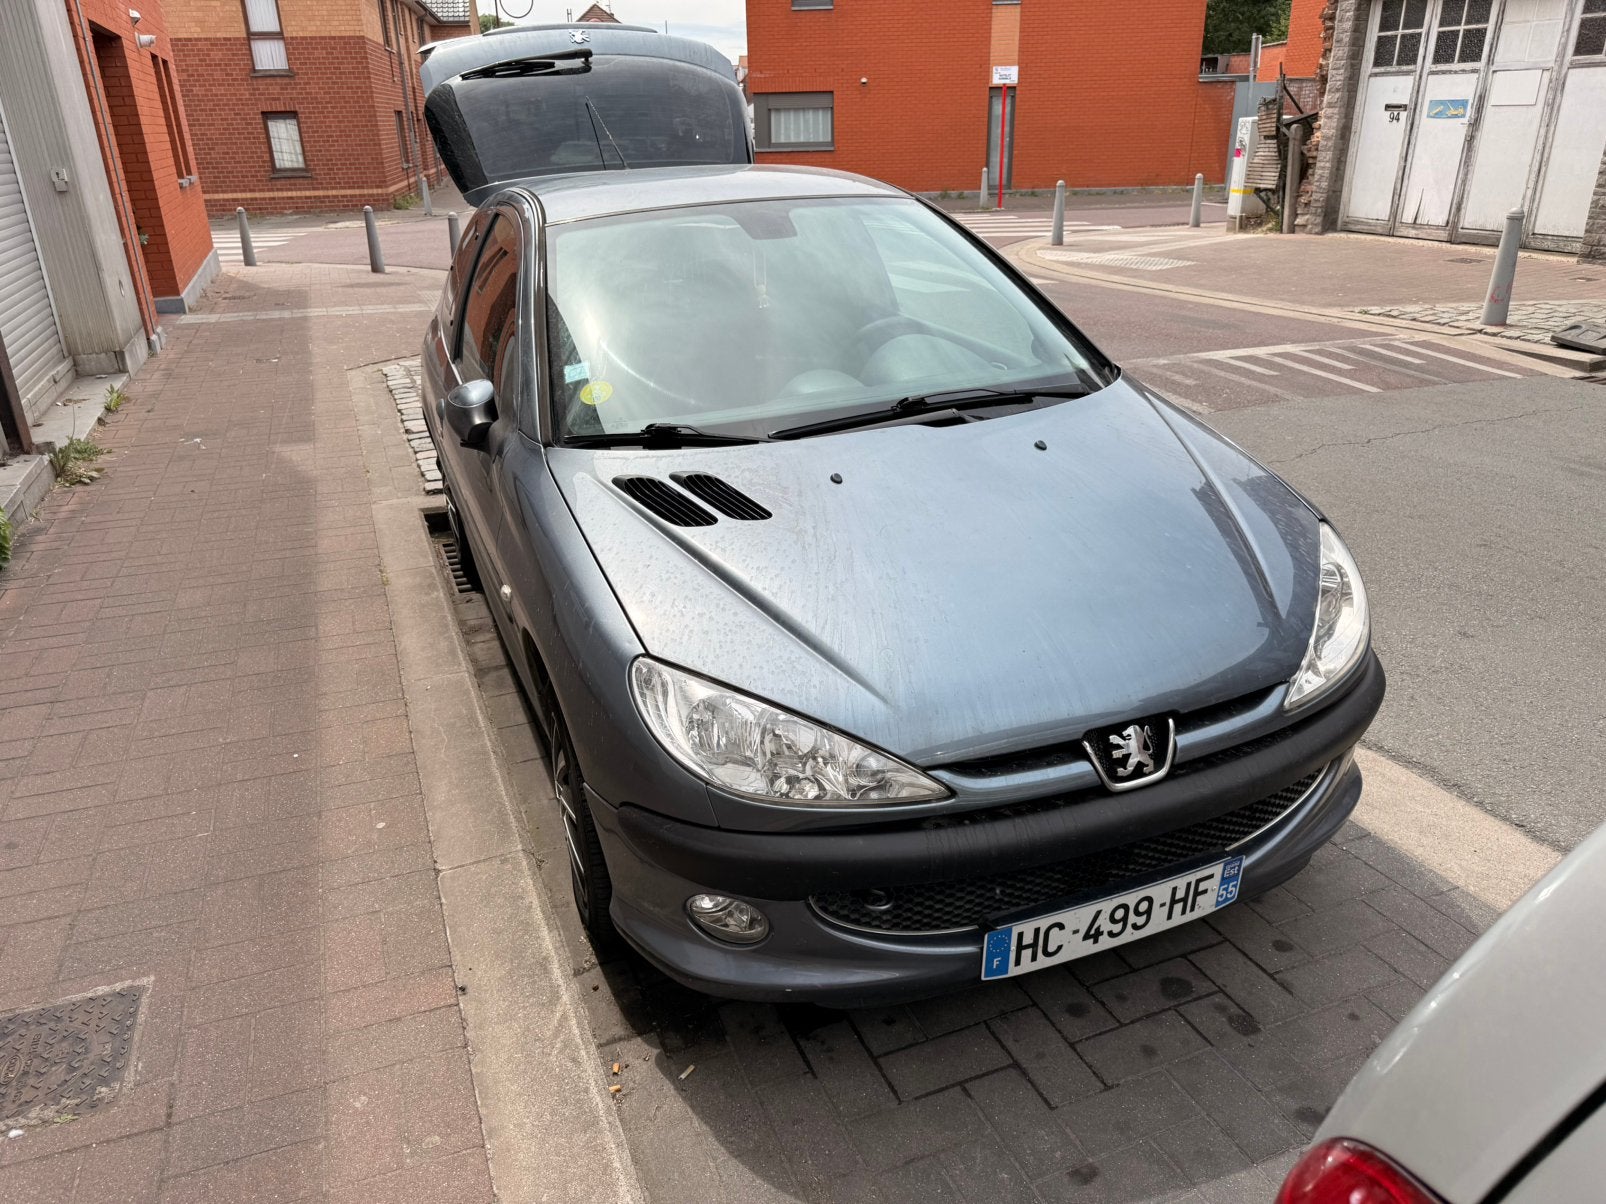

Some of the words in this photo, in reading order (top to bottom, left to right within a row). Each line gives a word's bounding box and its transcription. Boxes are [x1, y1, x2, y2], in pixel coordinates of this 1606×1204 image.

[1388, 112, 1401, 123] 94
[1217, 881, 1237, 901] 55
[1014, 873, 1215, 967] HC-499-HF
[993, 957, 1001, 969] F
